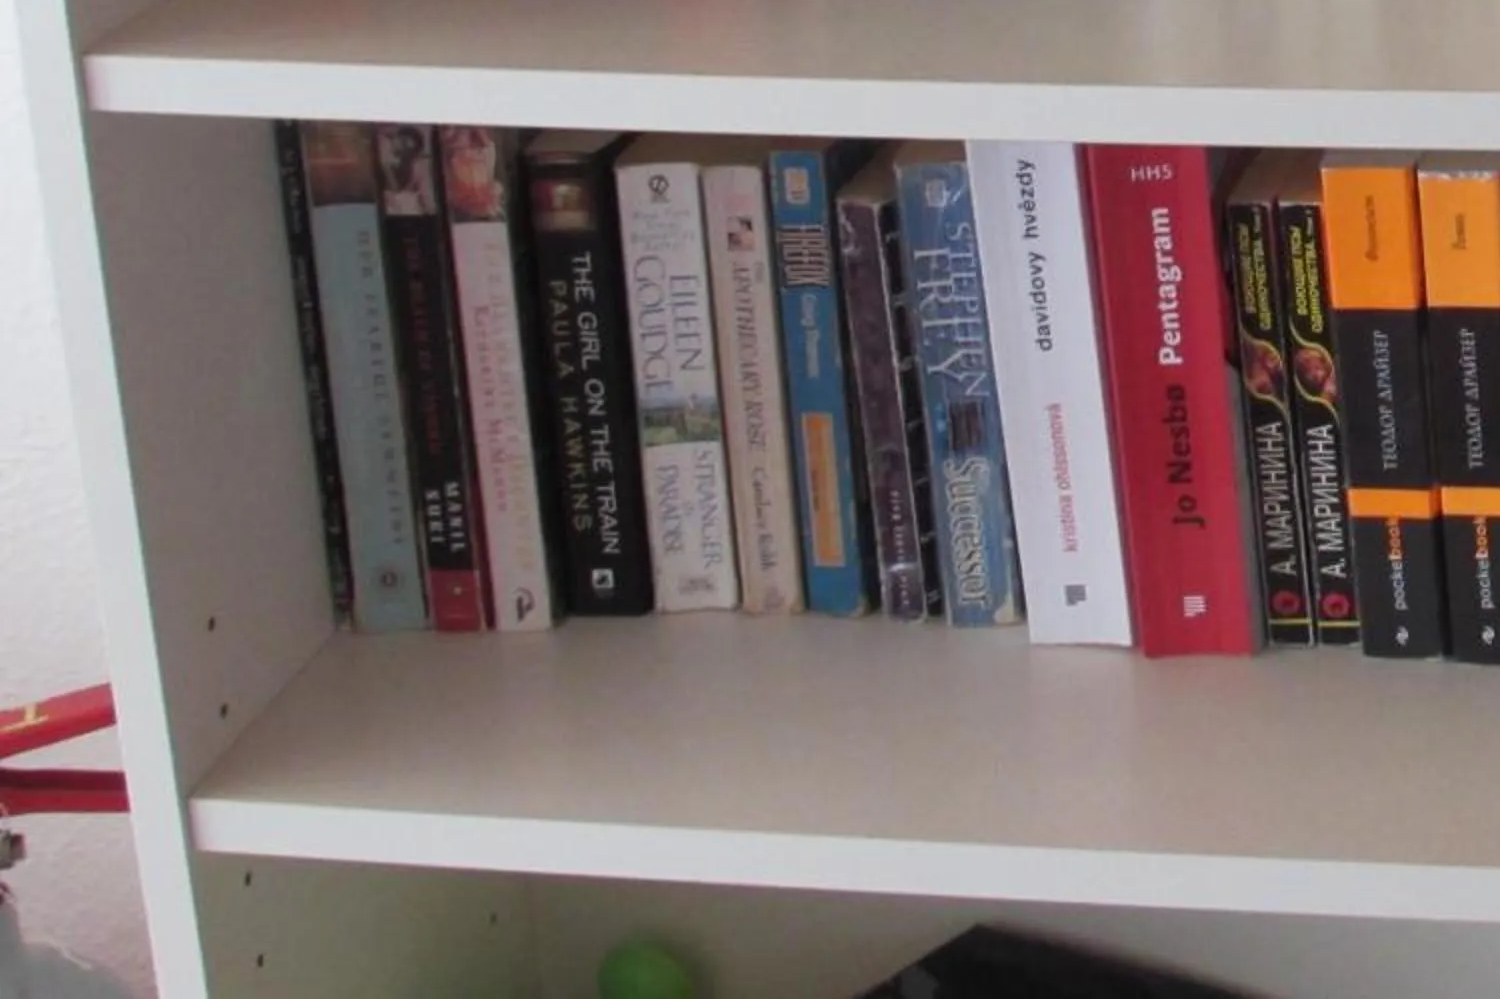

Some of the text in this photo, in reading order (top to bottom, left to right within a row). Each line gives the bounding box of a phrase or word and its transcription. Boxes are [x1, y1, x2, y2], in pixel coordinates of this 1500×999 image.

[633, 253, 673, 396] GOUDGE
[670, 273, 706, 373] EILEEN
[913, 247, 965, 383] FREY
[943, 221, 990, 399] STEPHEN
[1014, 158, 1055, 352] davidovy hvězdy
[548, 278, 592, 535] PAULA HAWKINS
[571, 251, 620, 556] THE GIRL ON THE TRAIN
[1148, 207, 1209, 529] Jo Nesbø Pentagram
[1372, 329, 1400, 471] ТЕОДОР ДРАЙЗЕР
[1458, 327, 1485, 470] ТЕОДОР ДРАЙЗЕР
[424, 489, 442, 543] SURI
[443, 481, 467, 554] MANIL
[692, 449, 723, 570] STRANGER
[941, 456, 993, 609] Successor
